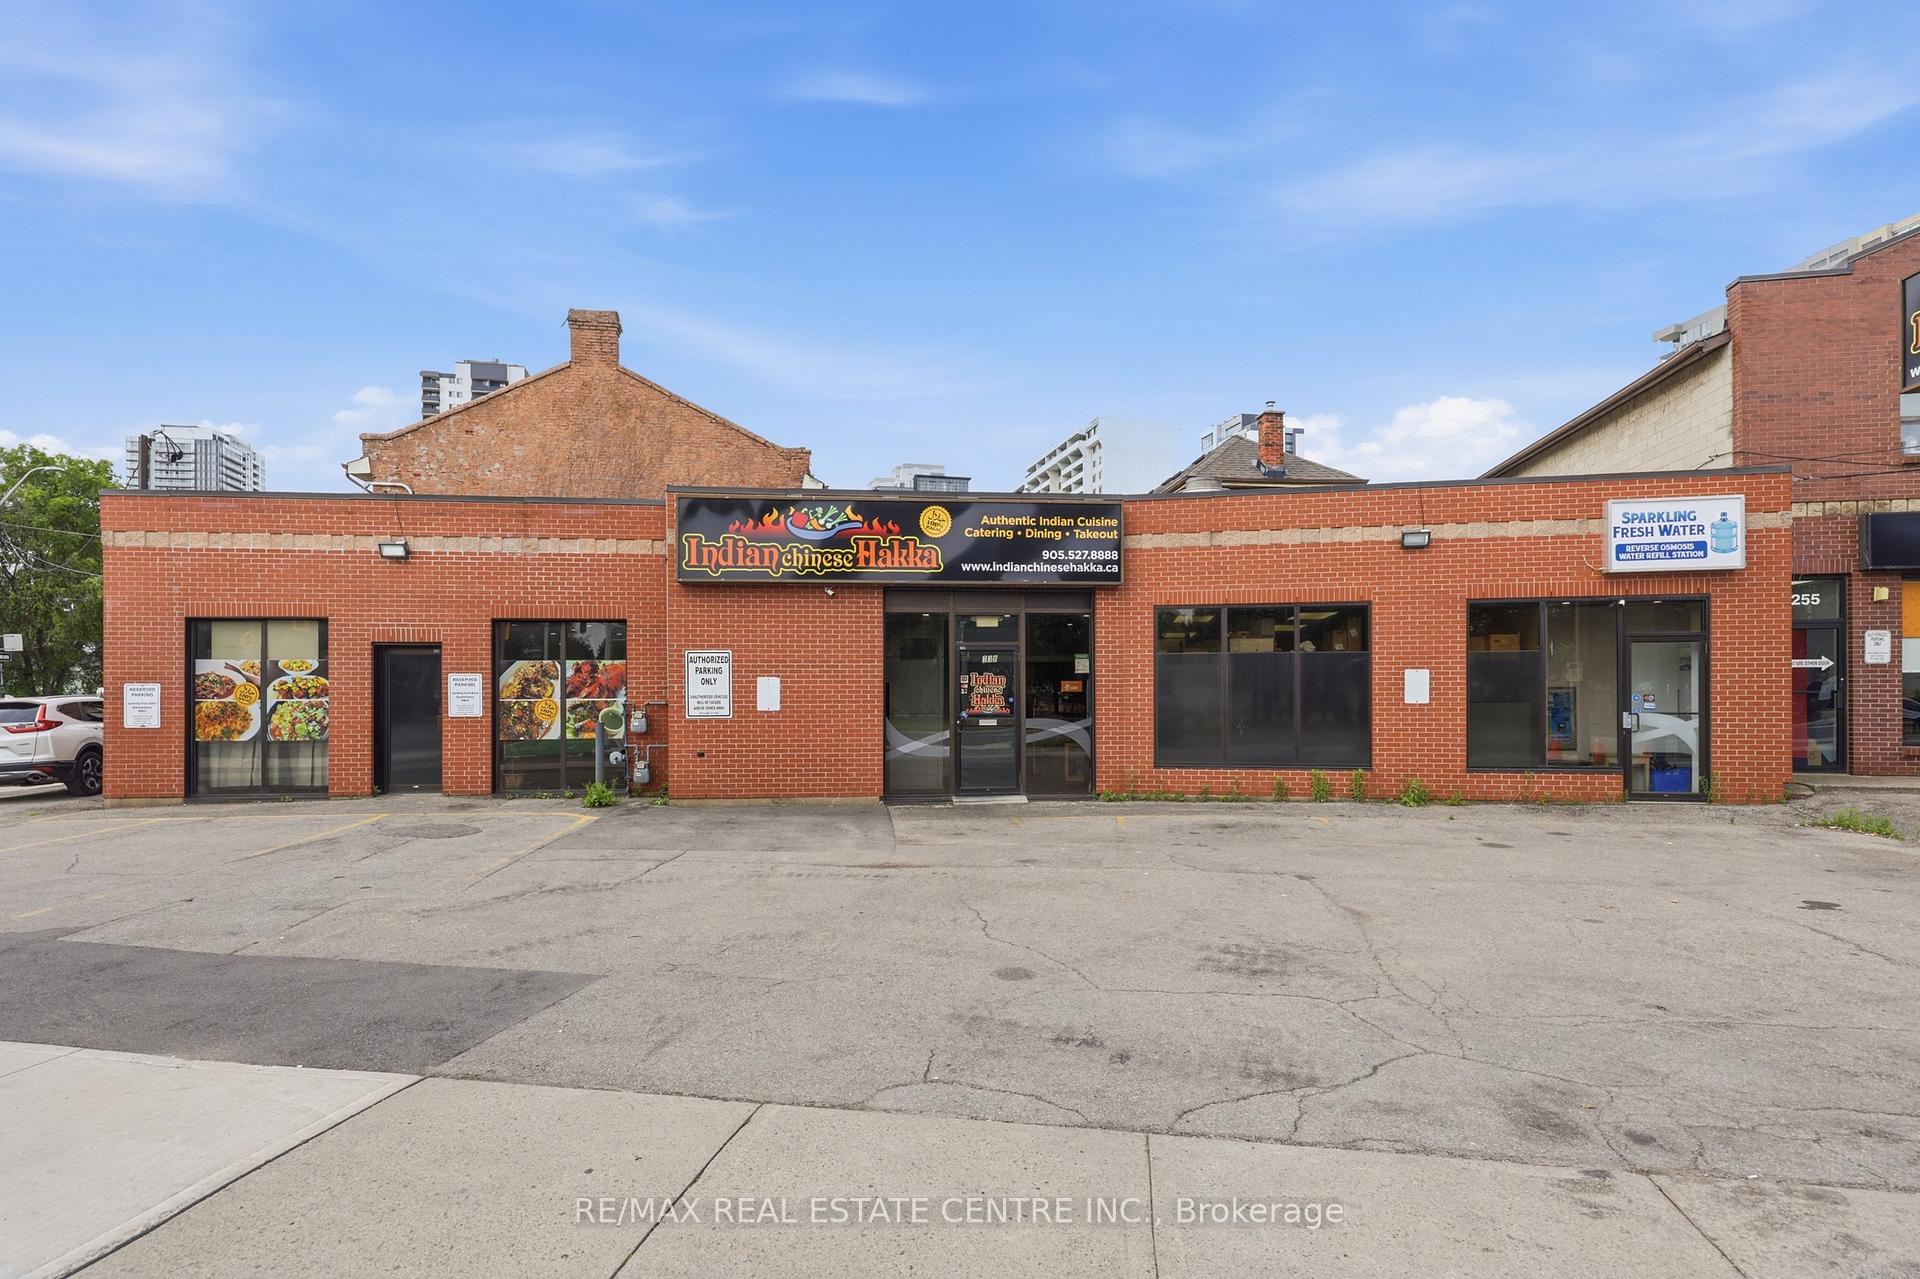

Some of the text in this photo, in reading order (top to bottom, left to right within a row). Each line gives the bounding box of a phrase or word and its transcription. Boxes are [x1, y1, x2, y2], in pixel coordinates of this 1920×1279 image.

[981, 515, 1118, 527] Authentic Indian Cuisine
[1622, 510, 1697, 524] SPARKLING
[964, 528, 1118, 540] Catering Dining Takeout
[1613, 524, 1705, 538] FRESH WATER
[1625, 543, 1694, 552] REVERSE OSMOSIS
[686, 537, 940, 571] Indian chinese Hakka
[1042, 550, 1118, 560] 905.527.8888
[1619, 550, 1704, 560] WATER REFILL STATION
[961, 562, 1118, 573] www.indianchinesehakka.ca
[1791, 593, 1820, 605] 255
[689, 656, 729, 664] AUTHORIZED
[971, 674, 1005, 687] Indian
[973, 694, 1002, 705] Hakka
